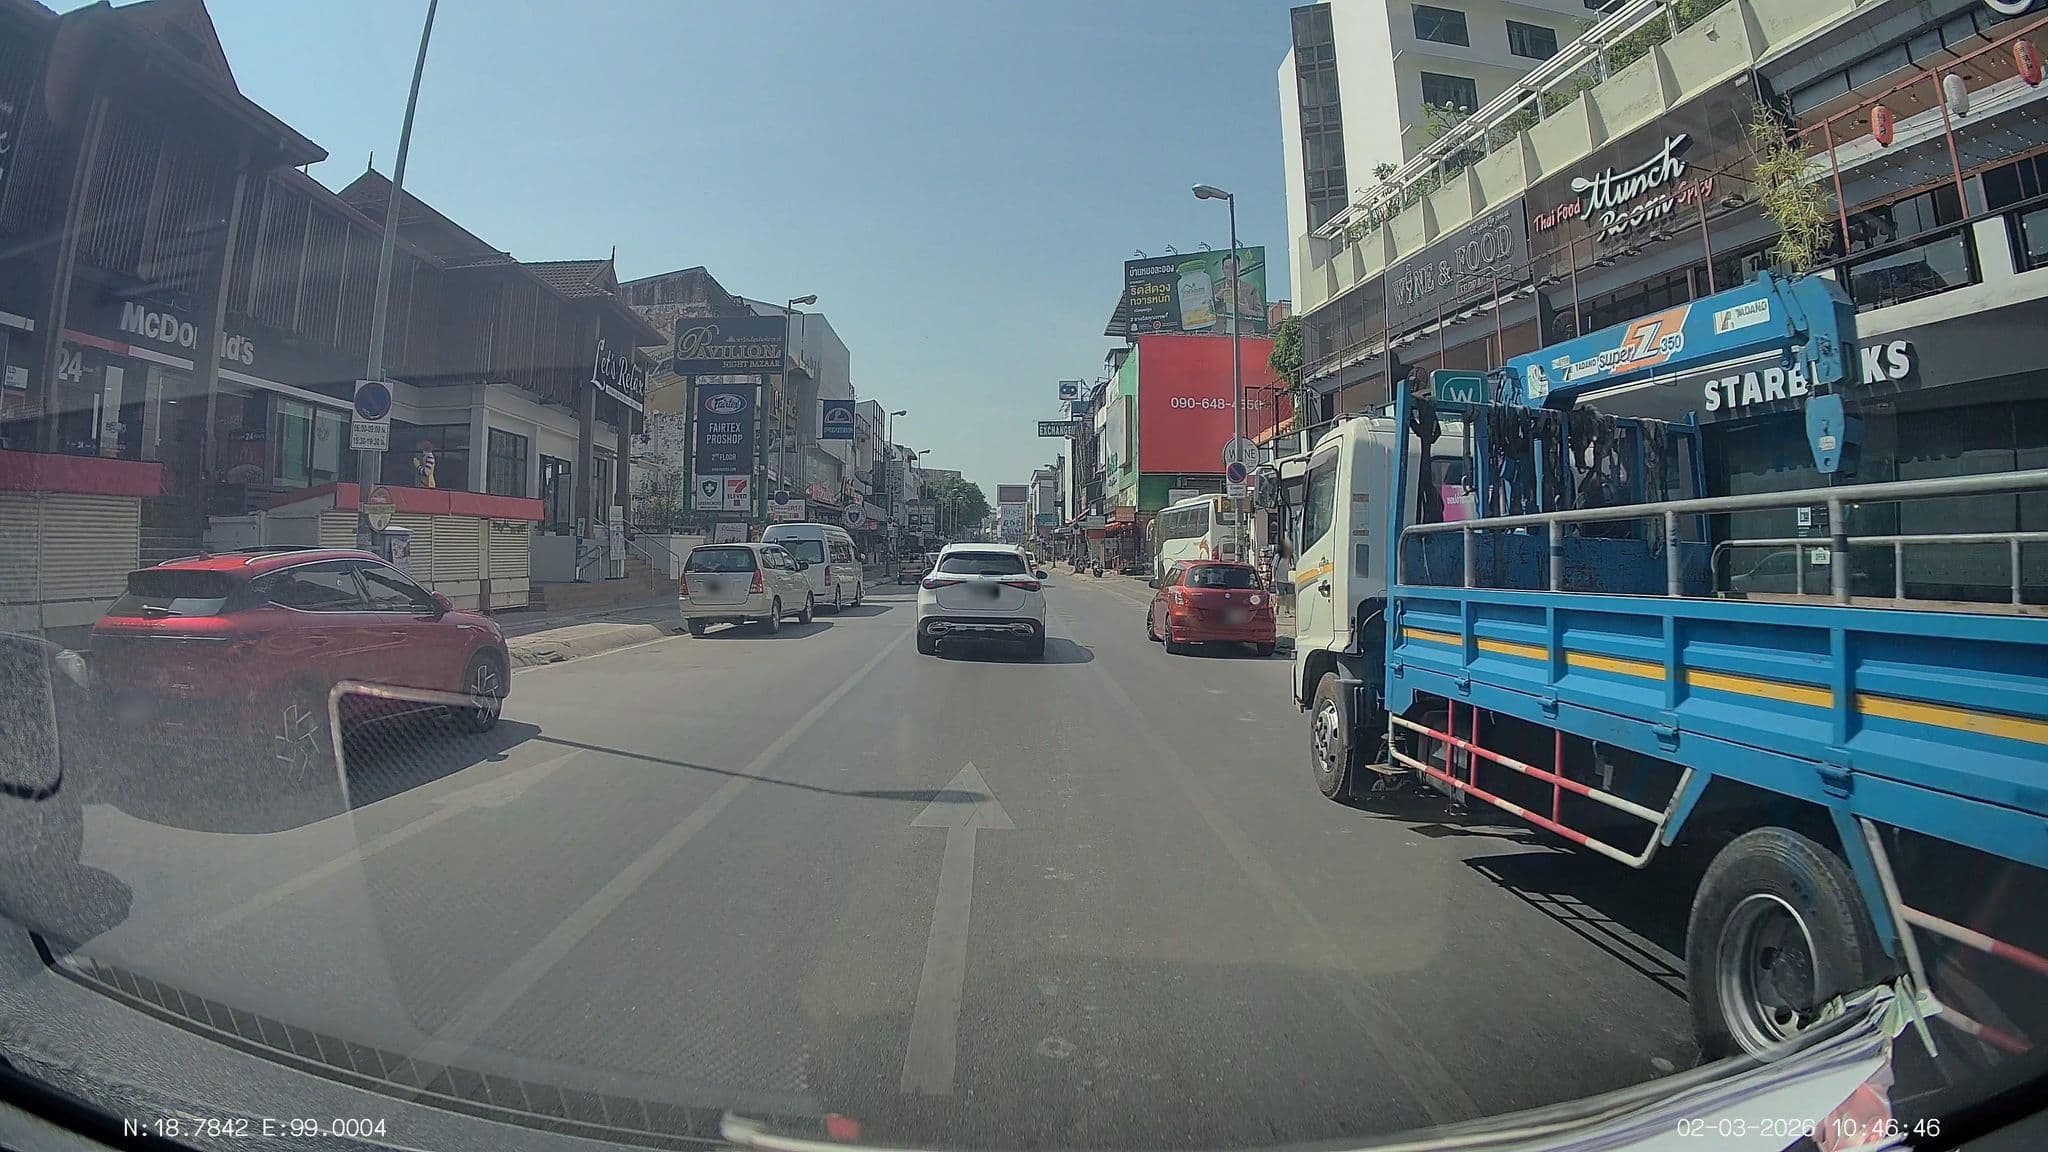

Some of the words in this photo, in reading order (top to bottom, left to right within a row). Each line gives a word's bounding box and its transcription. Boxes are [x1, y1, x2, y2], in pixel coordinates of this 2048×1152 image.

[1571, 133, 1688, 221] Munch
[1533, 209, 1556, 233] Thai
[1556, 196, 1582, 224] Food
[1597, 193, 1676, 243] Room
[1438, 260, 1454, 287] &
[1454, 223, 1514, 279] FOOD
[119, 301, 255, 366] McDold's
[1660, 334, 1683, 353] 350
[57, 350, 83, 384] 24
[590, 336, 617, 392] Let's
[1704, 340, 1911, 412] STARBKS
[706, 434, 743, 445] PROSHOP
[709, 422, 742, 433] FAIRTEX
[1228, 448, 1256, 459] WNE
